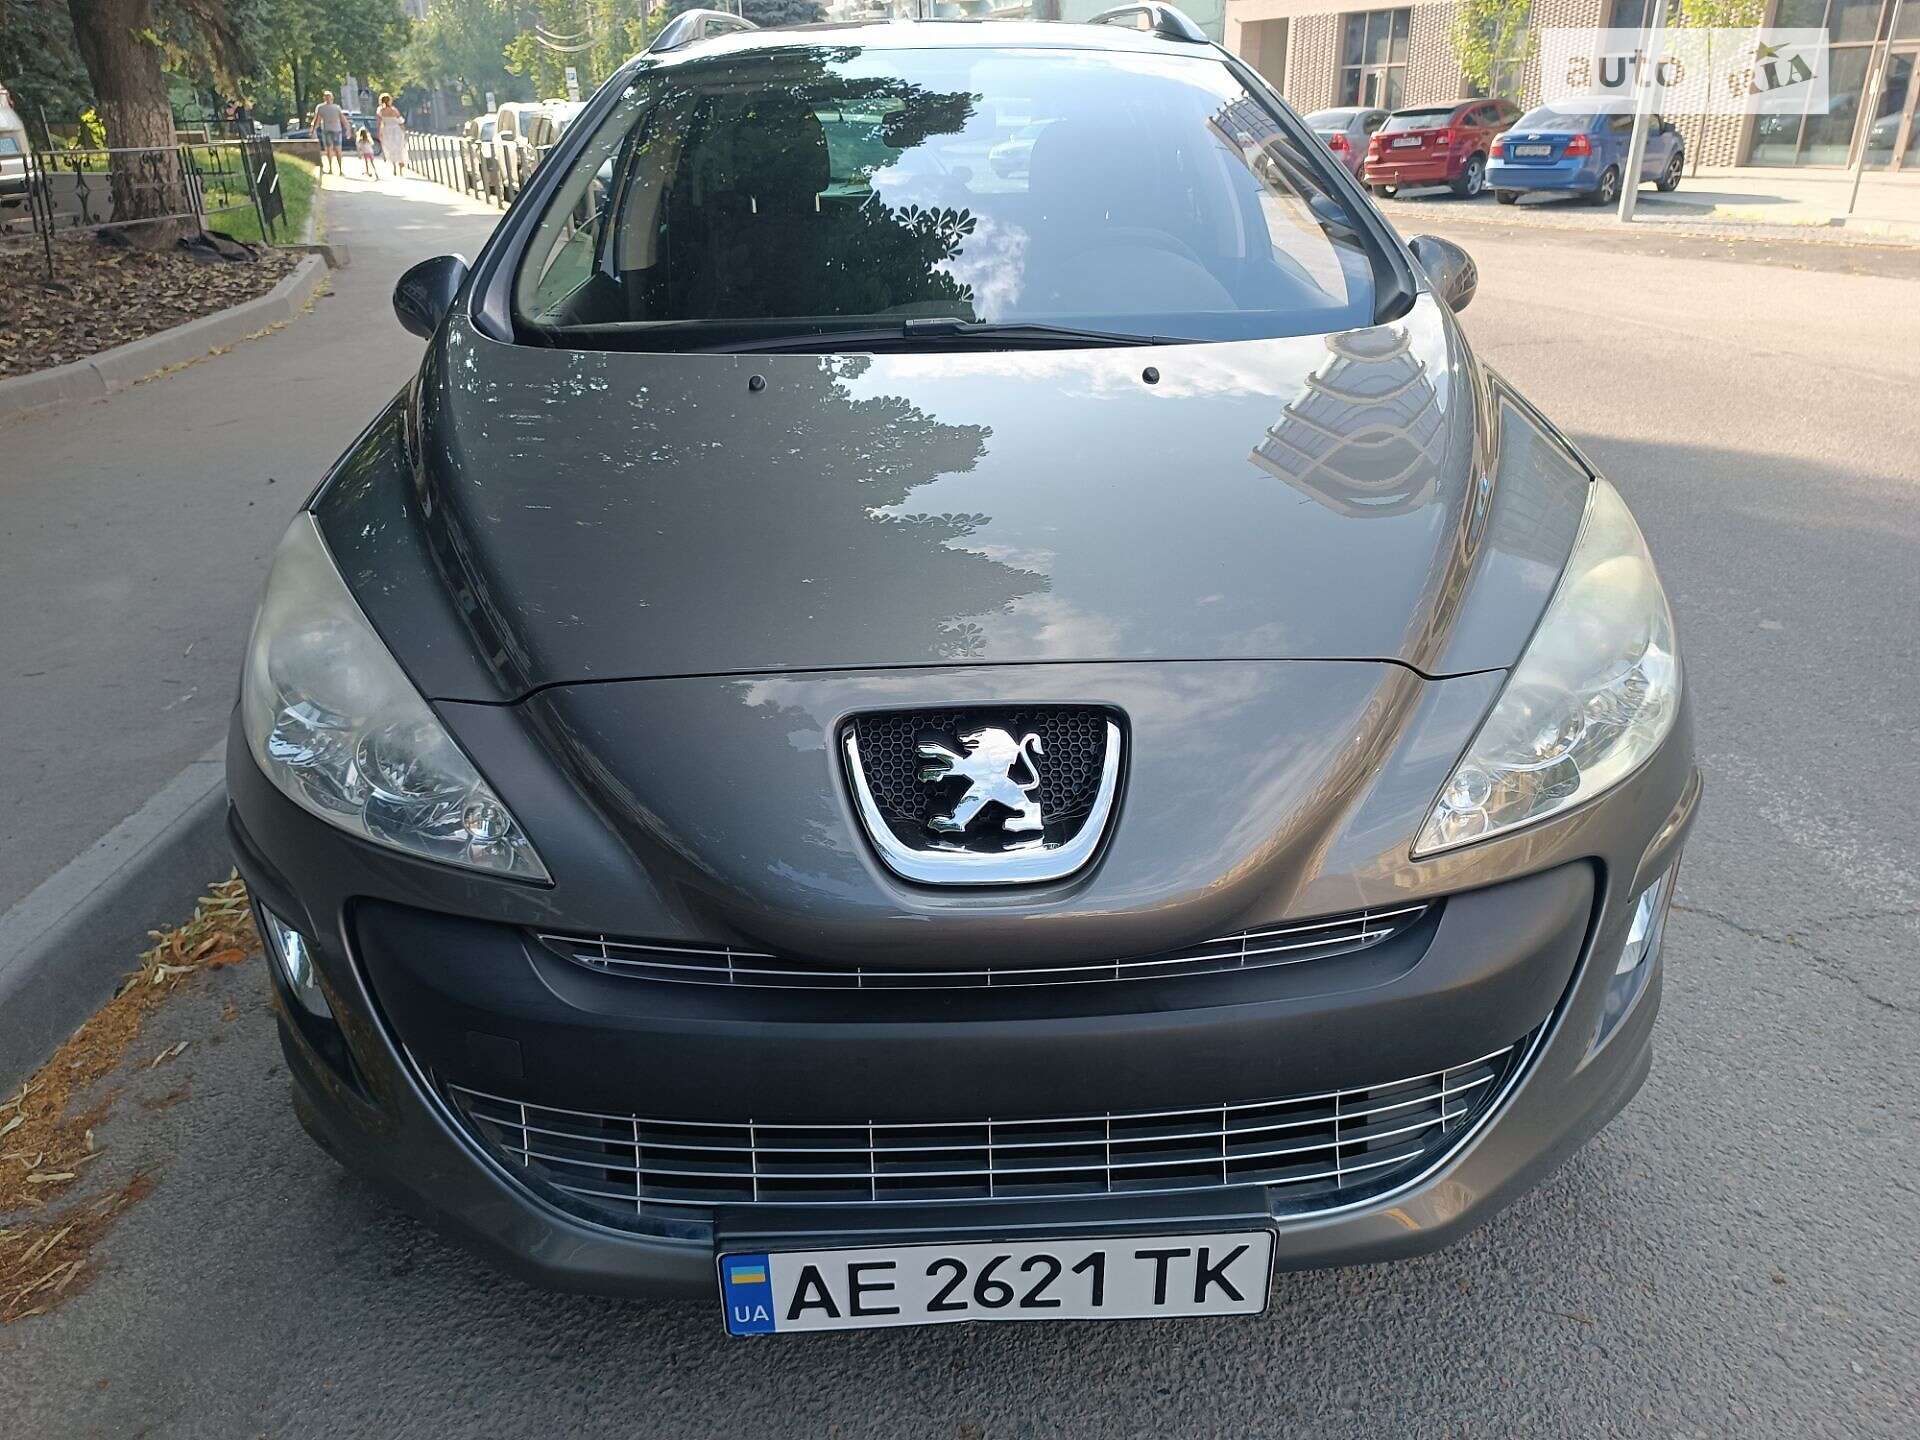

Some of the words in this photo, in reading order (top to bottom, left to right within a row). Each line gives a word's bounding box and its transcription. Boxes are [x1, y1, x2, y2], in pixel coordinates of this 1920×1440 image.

[786, 1261, 901, 1321] AE
[926, 1251, 1106, 1312] 2621
[1134, 1244, 1250, 1306] TK
[734, 1305, 770, 1323] UA
